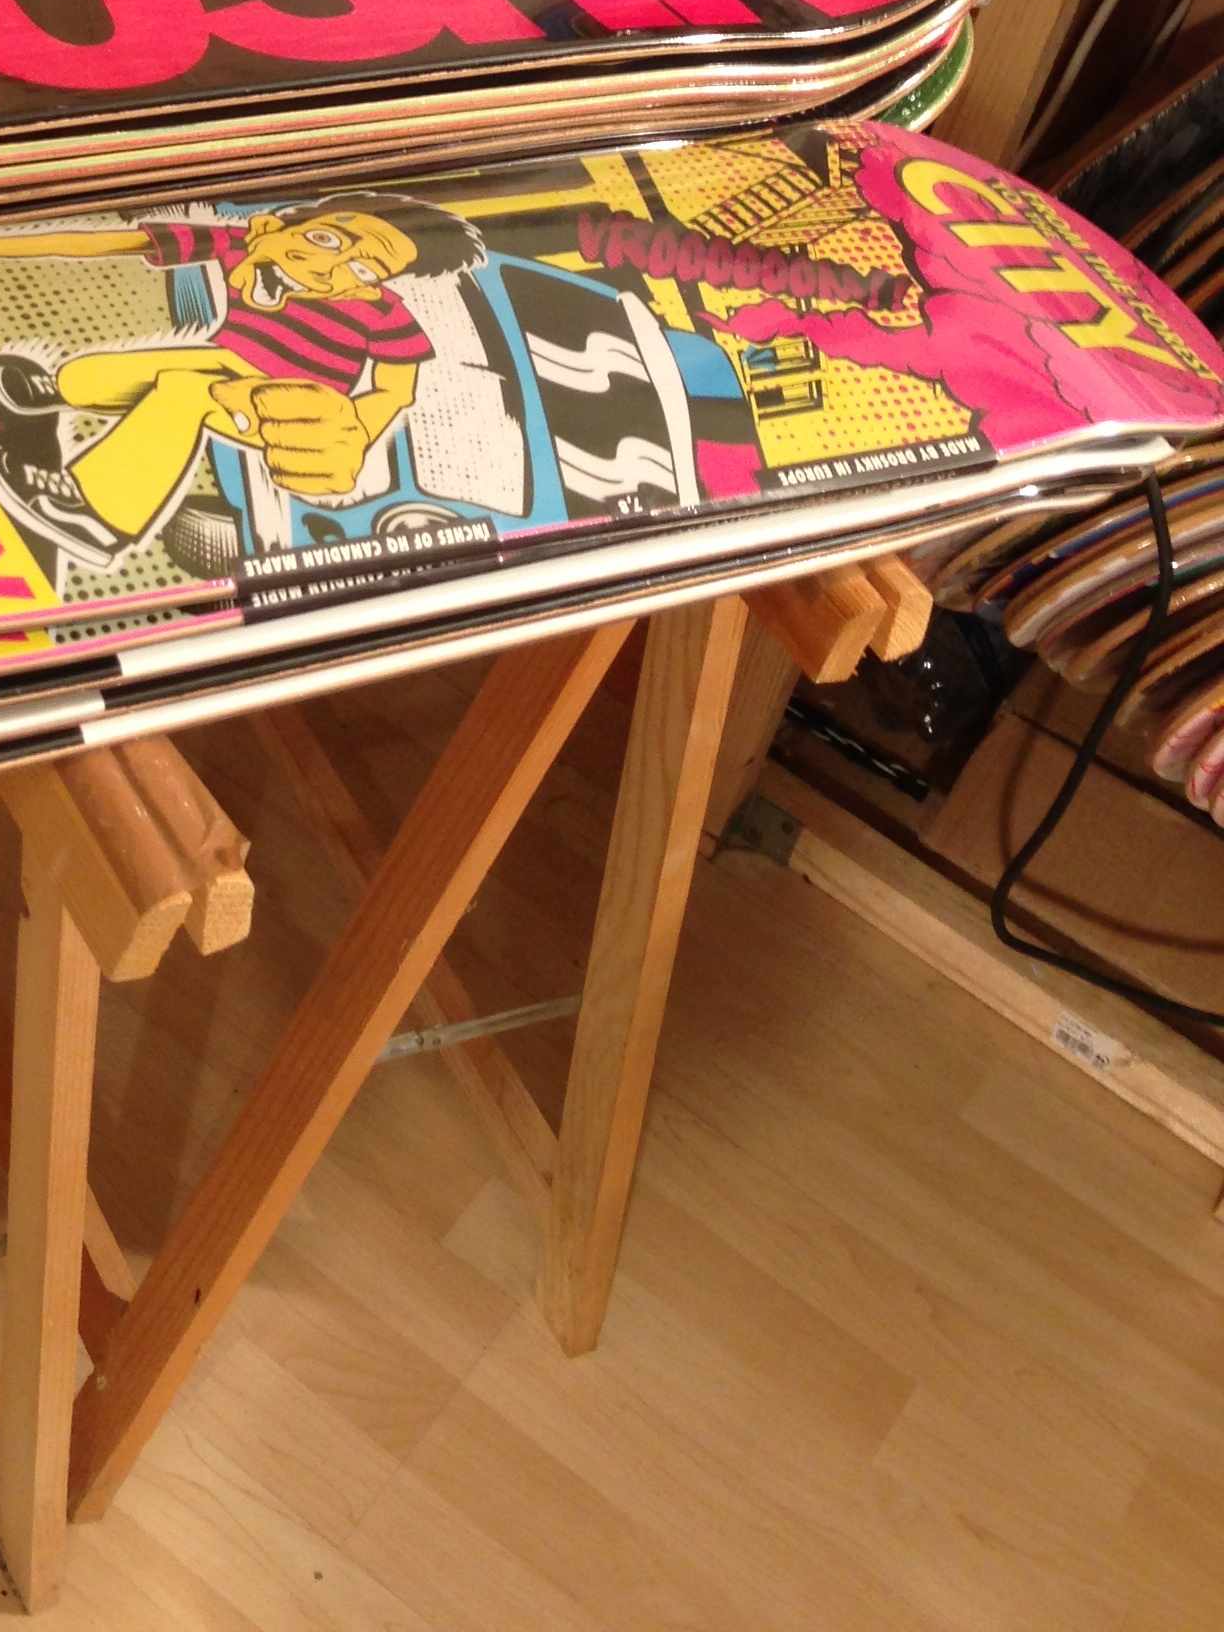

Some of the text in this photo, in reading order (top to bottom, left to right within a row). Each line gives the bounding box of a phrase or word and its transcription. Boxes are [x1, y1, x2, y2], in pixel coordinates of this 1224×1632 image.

[900, 159, 1188, 372] CITY
[777, 435, 981, 487] MADE BY DROSHKY IN EUROPE
[243, 522, 491, 578] INCHES OF HQ CANADIAN MAPLE
